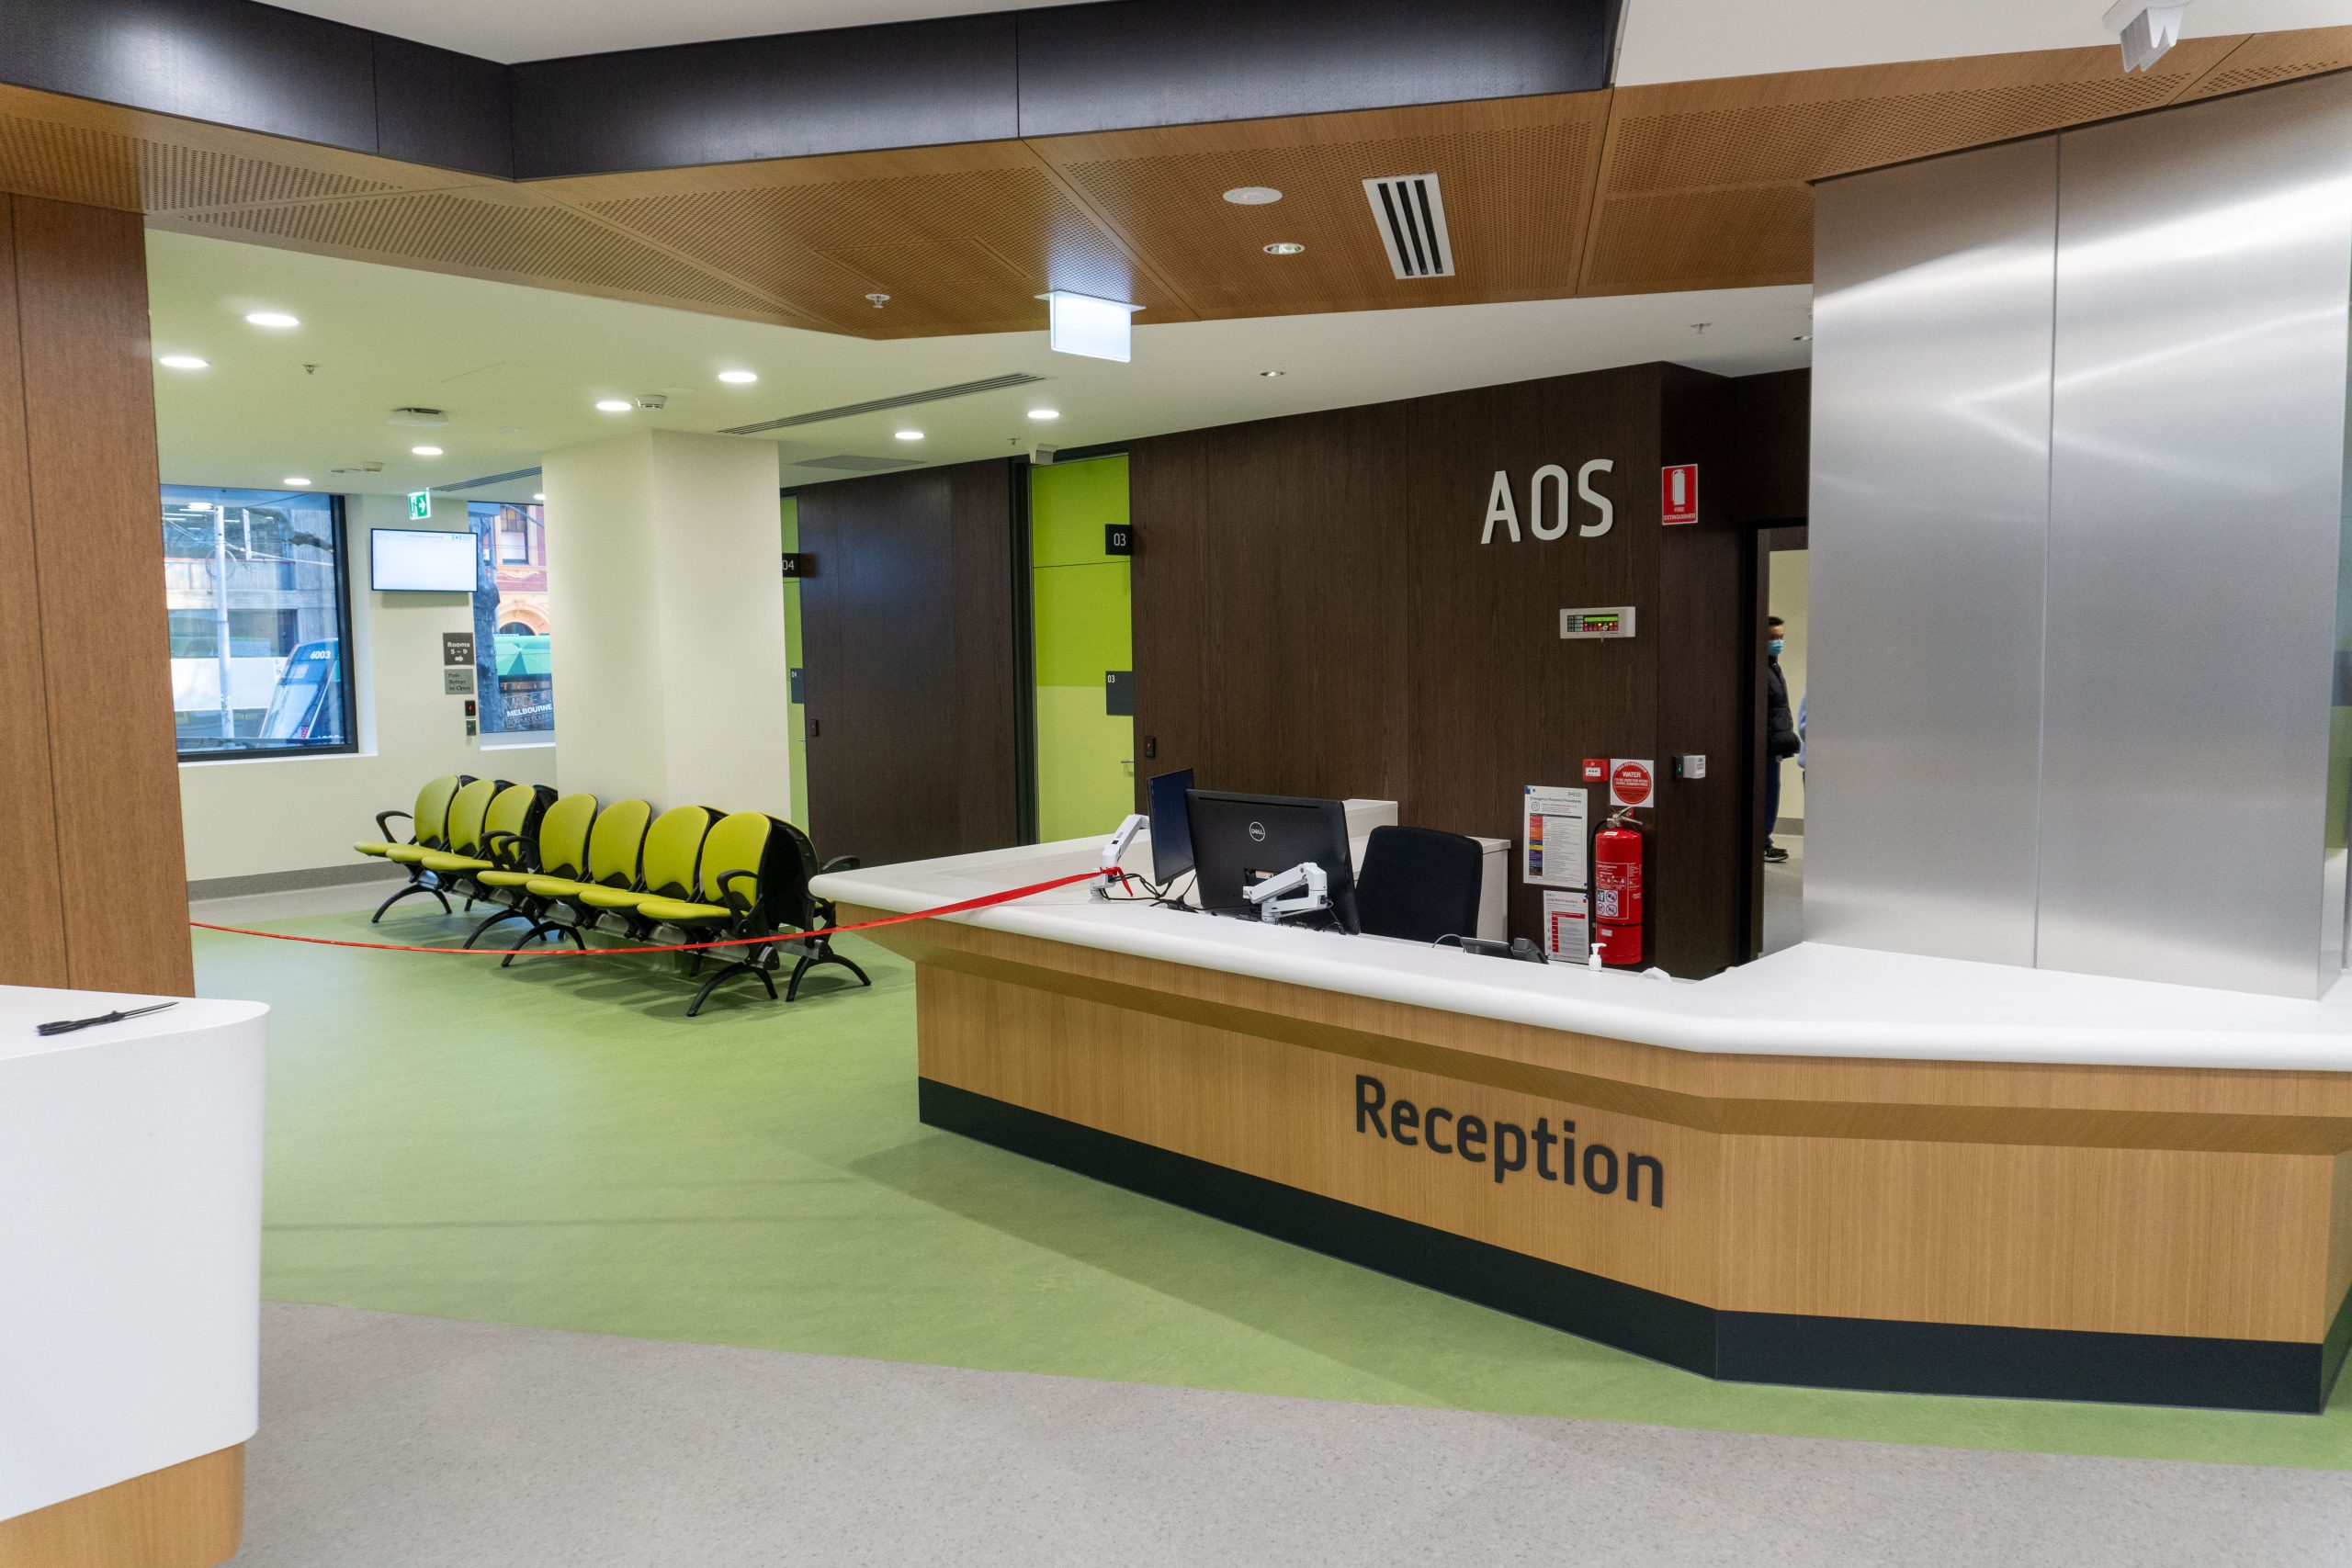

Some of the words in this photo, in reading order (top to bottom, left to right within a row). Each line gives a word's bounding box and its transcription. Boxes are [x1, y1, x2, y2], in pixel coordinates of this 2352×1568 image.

[1481, 458, 1614, 545] AOS
[1664, 513, 1696, 521] EXTINGUISHER
[1114, 533, 1126, 547] 03
[782, 559, 795, 570] 04
[311, 650, 331, 660] 6003
[1107, 674, 1115, 683] 03
[506, 704, 553, 717] MELBOURNE
[1355, 1074, 1664, 1209] Reception
